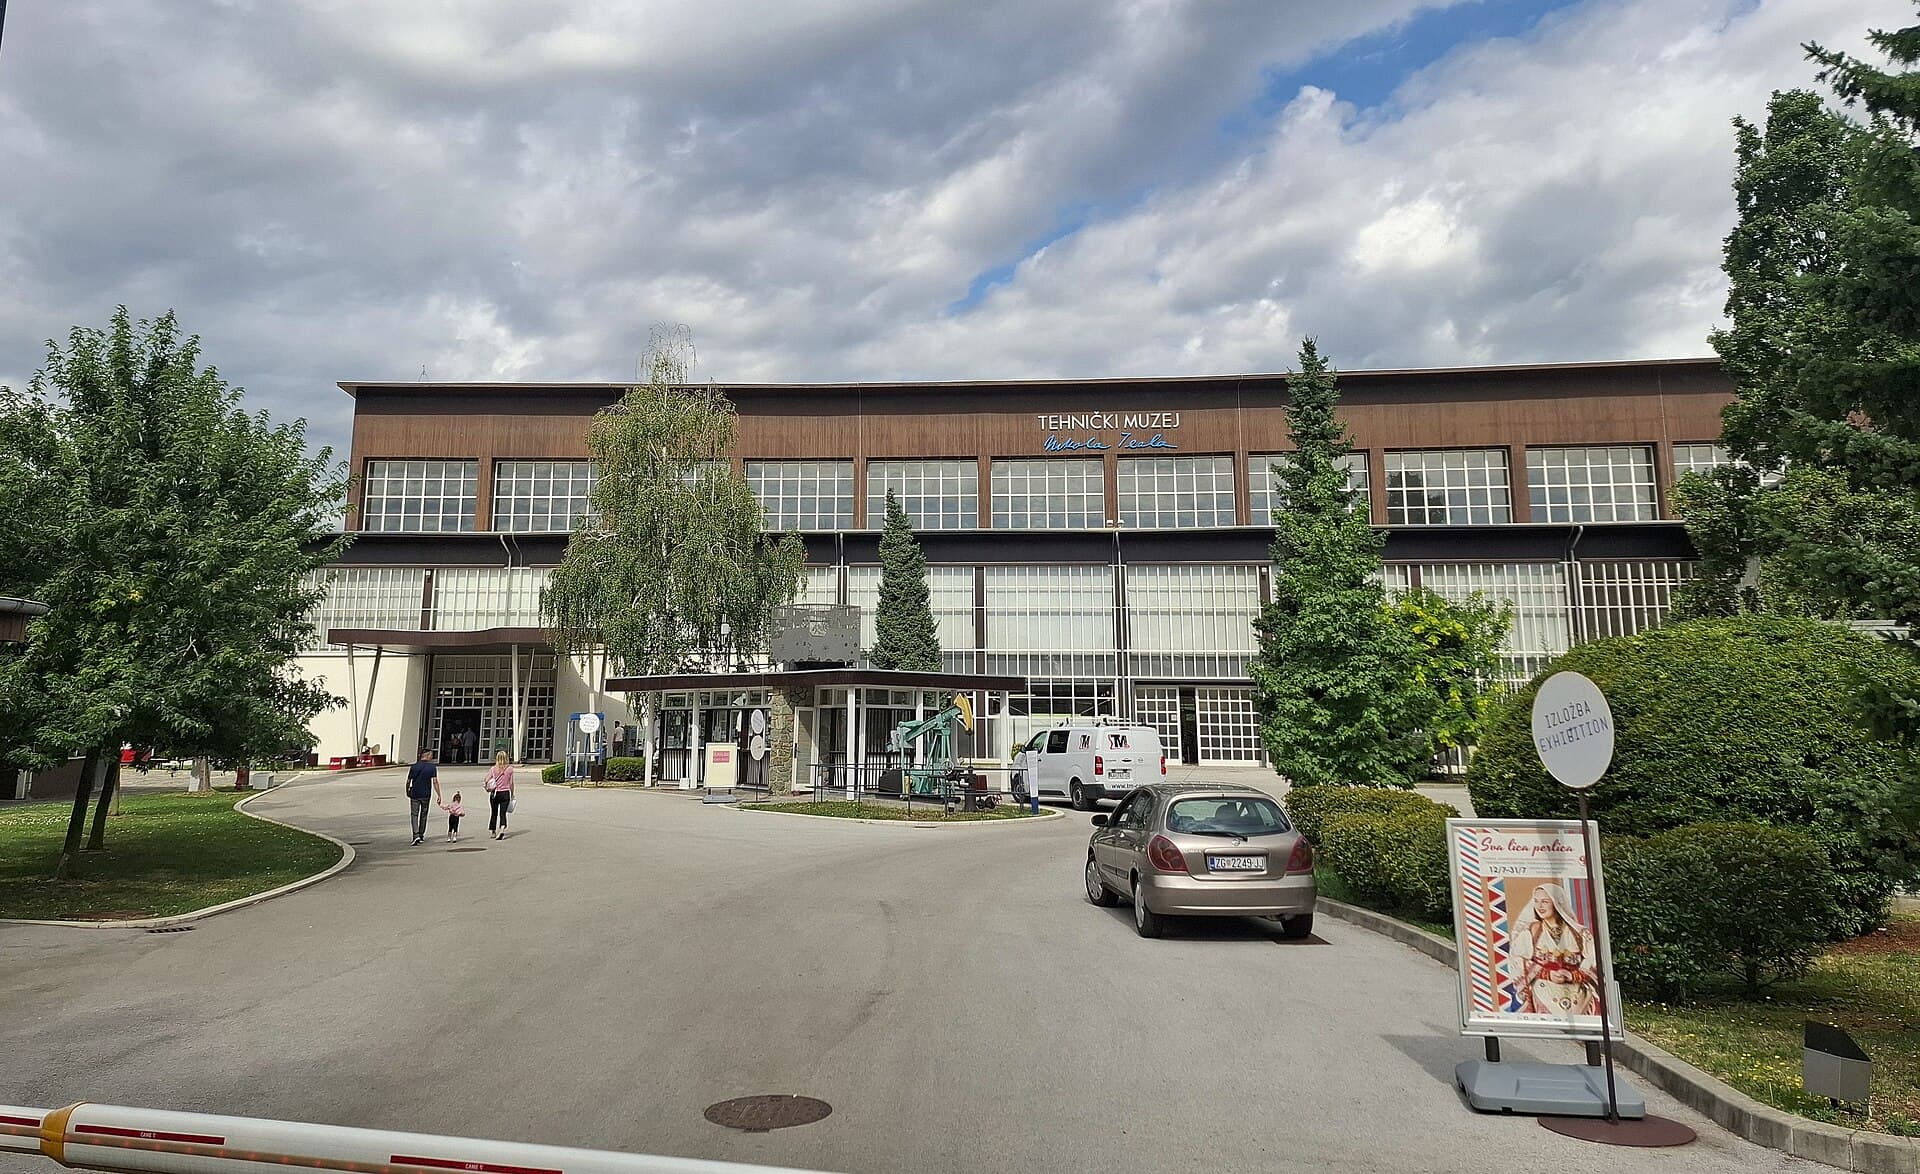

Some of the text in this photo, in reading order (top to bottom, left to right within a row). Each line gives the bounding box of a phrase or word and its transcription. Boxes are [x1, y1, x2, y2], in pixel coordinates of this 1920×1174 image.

[1038, 411, 1180, 430] TEHNIČKI MUZEJ
[1043, 434, 1111, 451] Nikola
[1545, 700, 1591, 728] IZLOŽBA
[1539, 716, 1609, 752] EXHIBITION
[1481, 837, 1574, 856] Sva lica perlica
[1216, 858, 1226, 868] ZG
